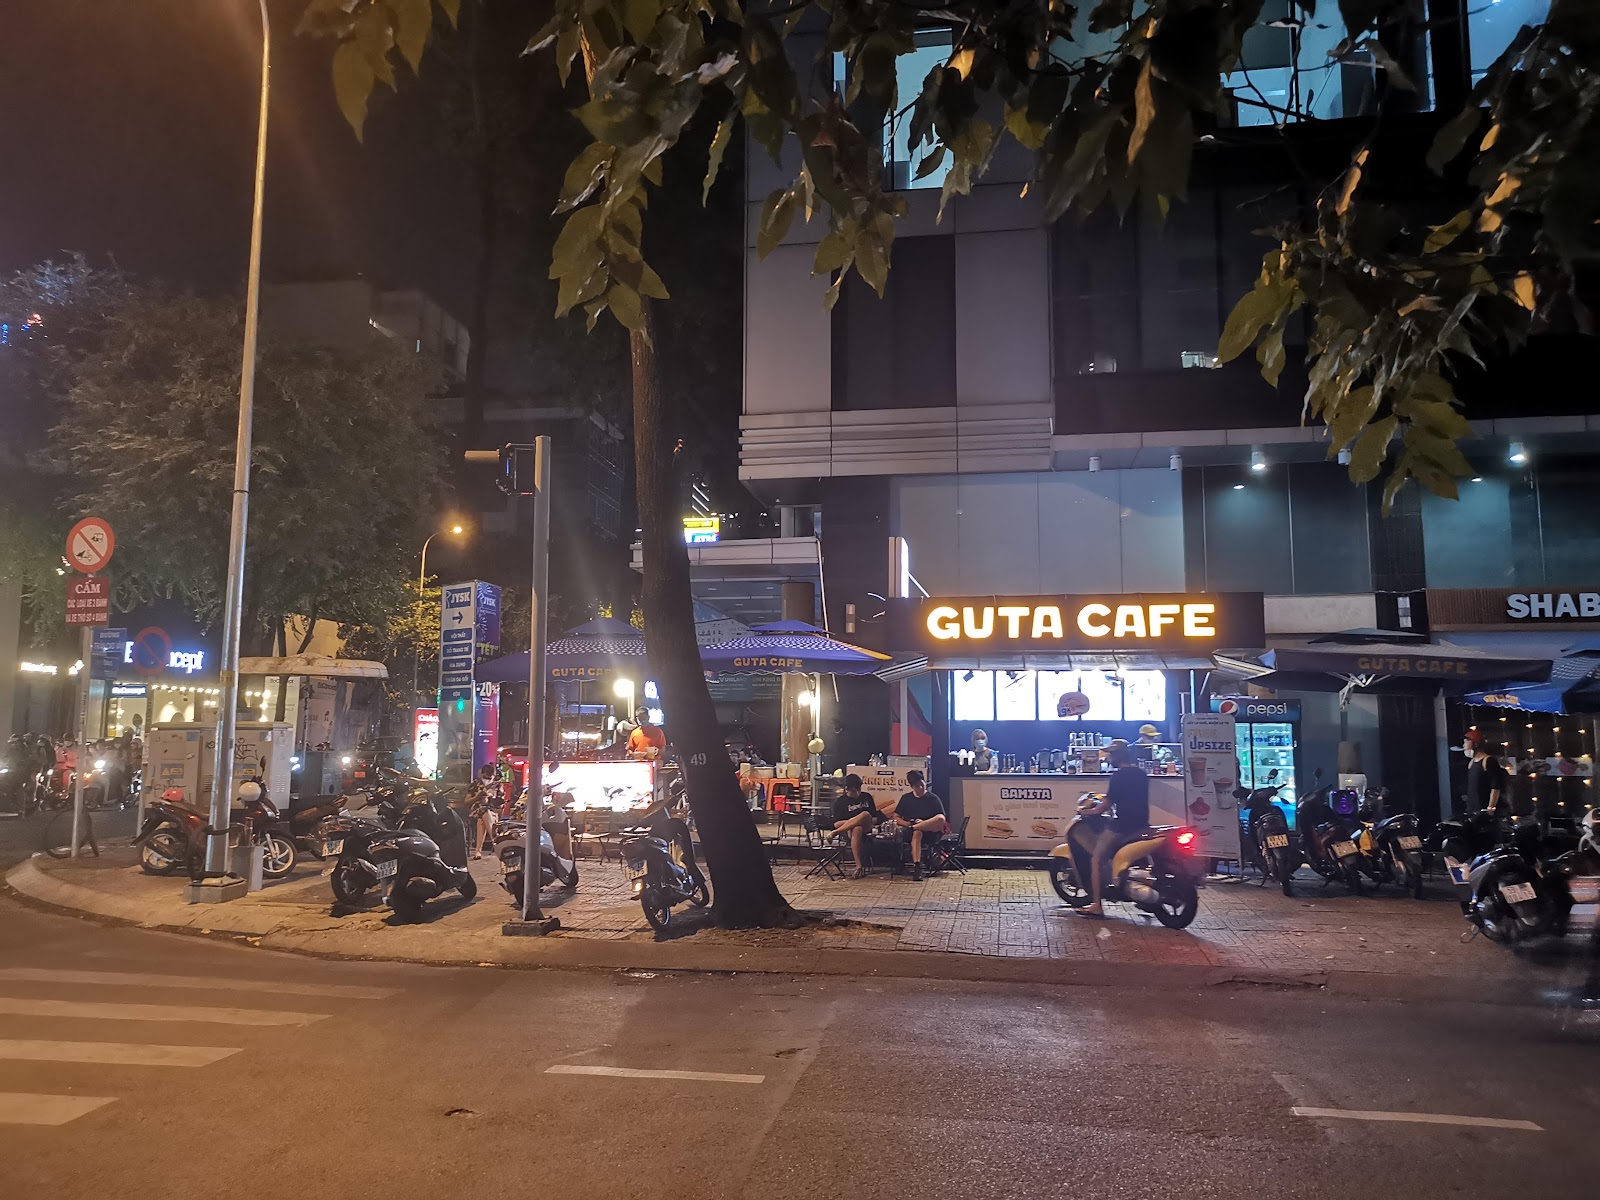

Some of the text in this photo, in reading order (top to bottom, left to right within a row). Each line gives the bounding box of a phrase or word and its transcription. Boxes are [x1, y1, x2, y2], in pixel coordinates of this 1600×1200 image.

[75, 580, 101, 594] CẤM
[450, 592, 470, 603] JYSK
[926, 603, 1216, 640] GUTA CAFE
[733, 657, 803, 668] GUTA CAFE
[1358, 657, 1469, 674] GUTA CAFE
[552, 667, 585, 677] GUTA
[1246, 702, 1288, 717] pepsi
[1189, 736, 1233, 751] UPSIZE
[690, 752, 707, 766] 49
[1001, 787, 1052, 800] BAMITA
